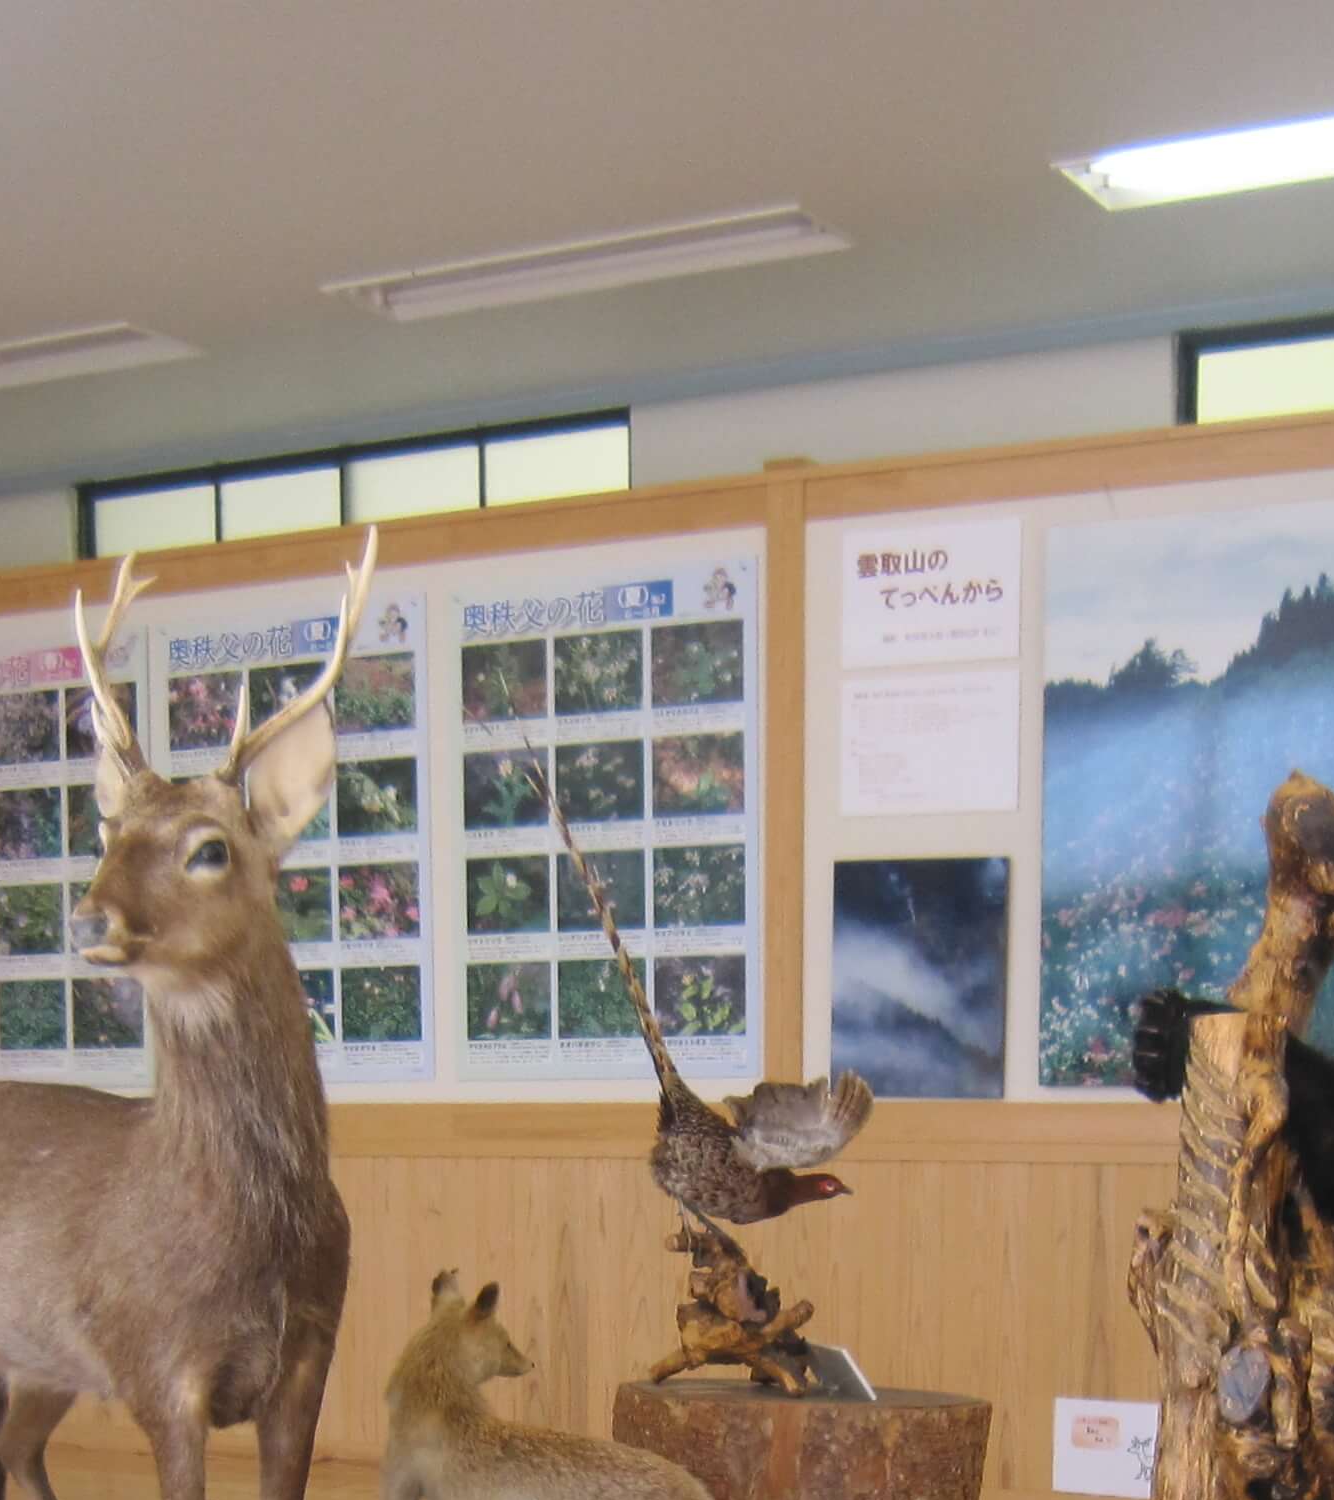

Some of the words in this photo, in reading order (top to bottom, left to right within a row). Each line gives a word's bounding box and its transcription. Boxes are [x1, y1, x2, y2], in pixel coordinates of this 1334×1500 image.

[462, 592, 607, 635] 奥秩父の花
[169, 625, 294, 666] 奥秩父の花
